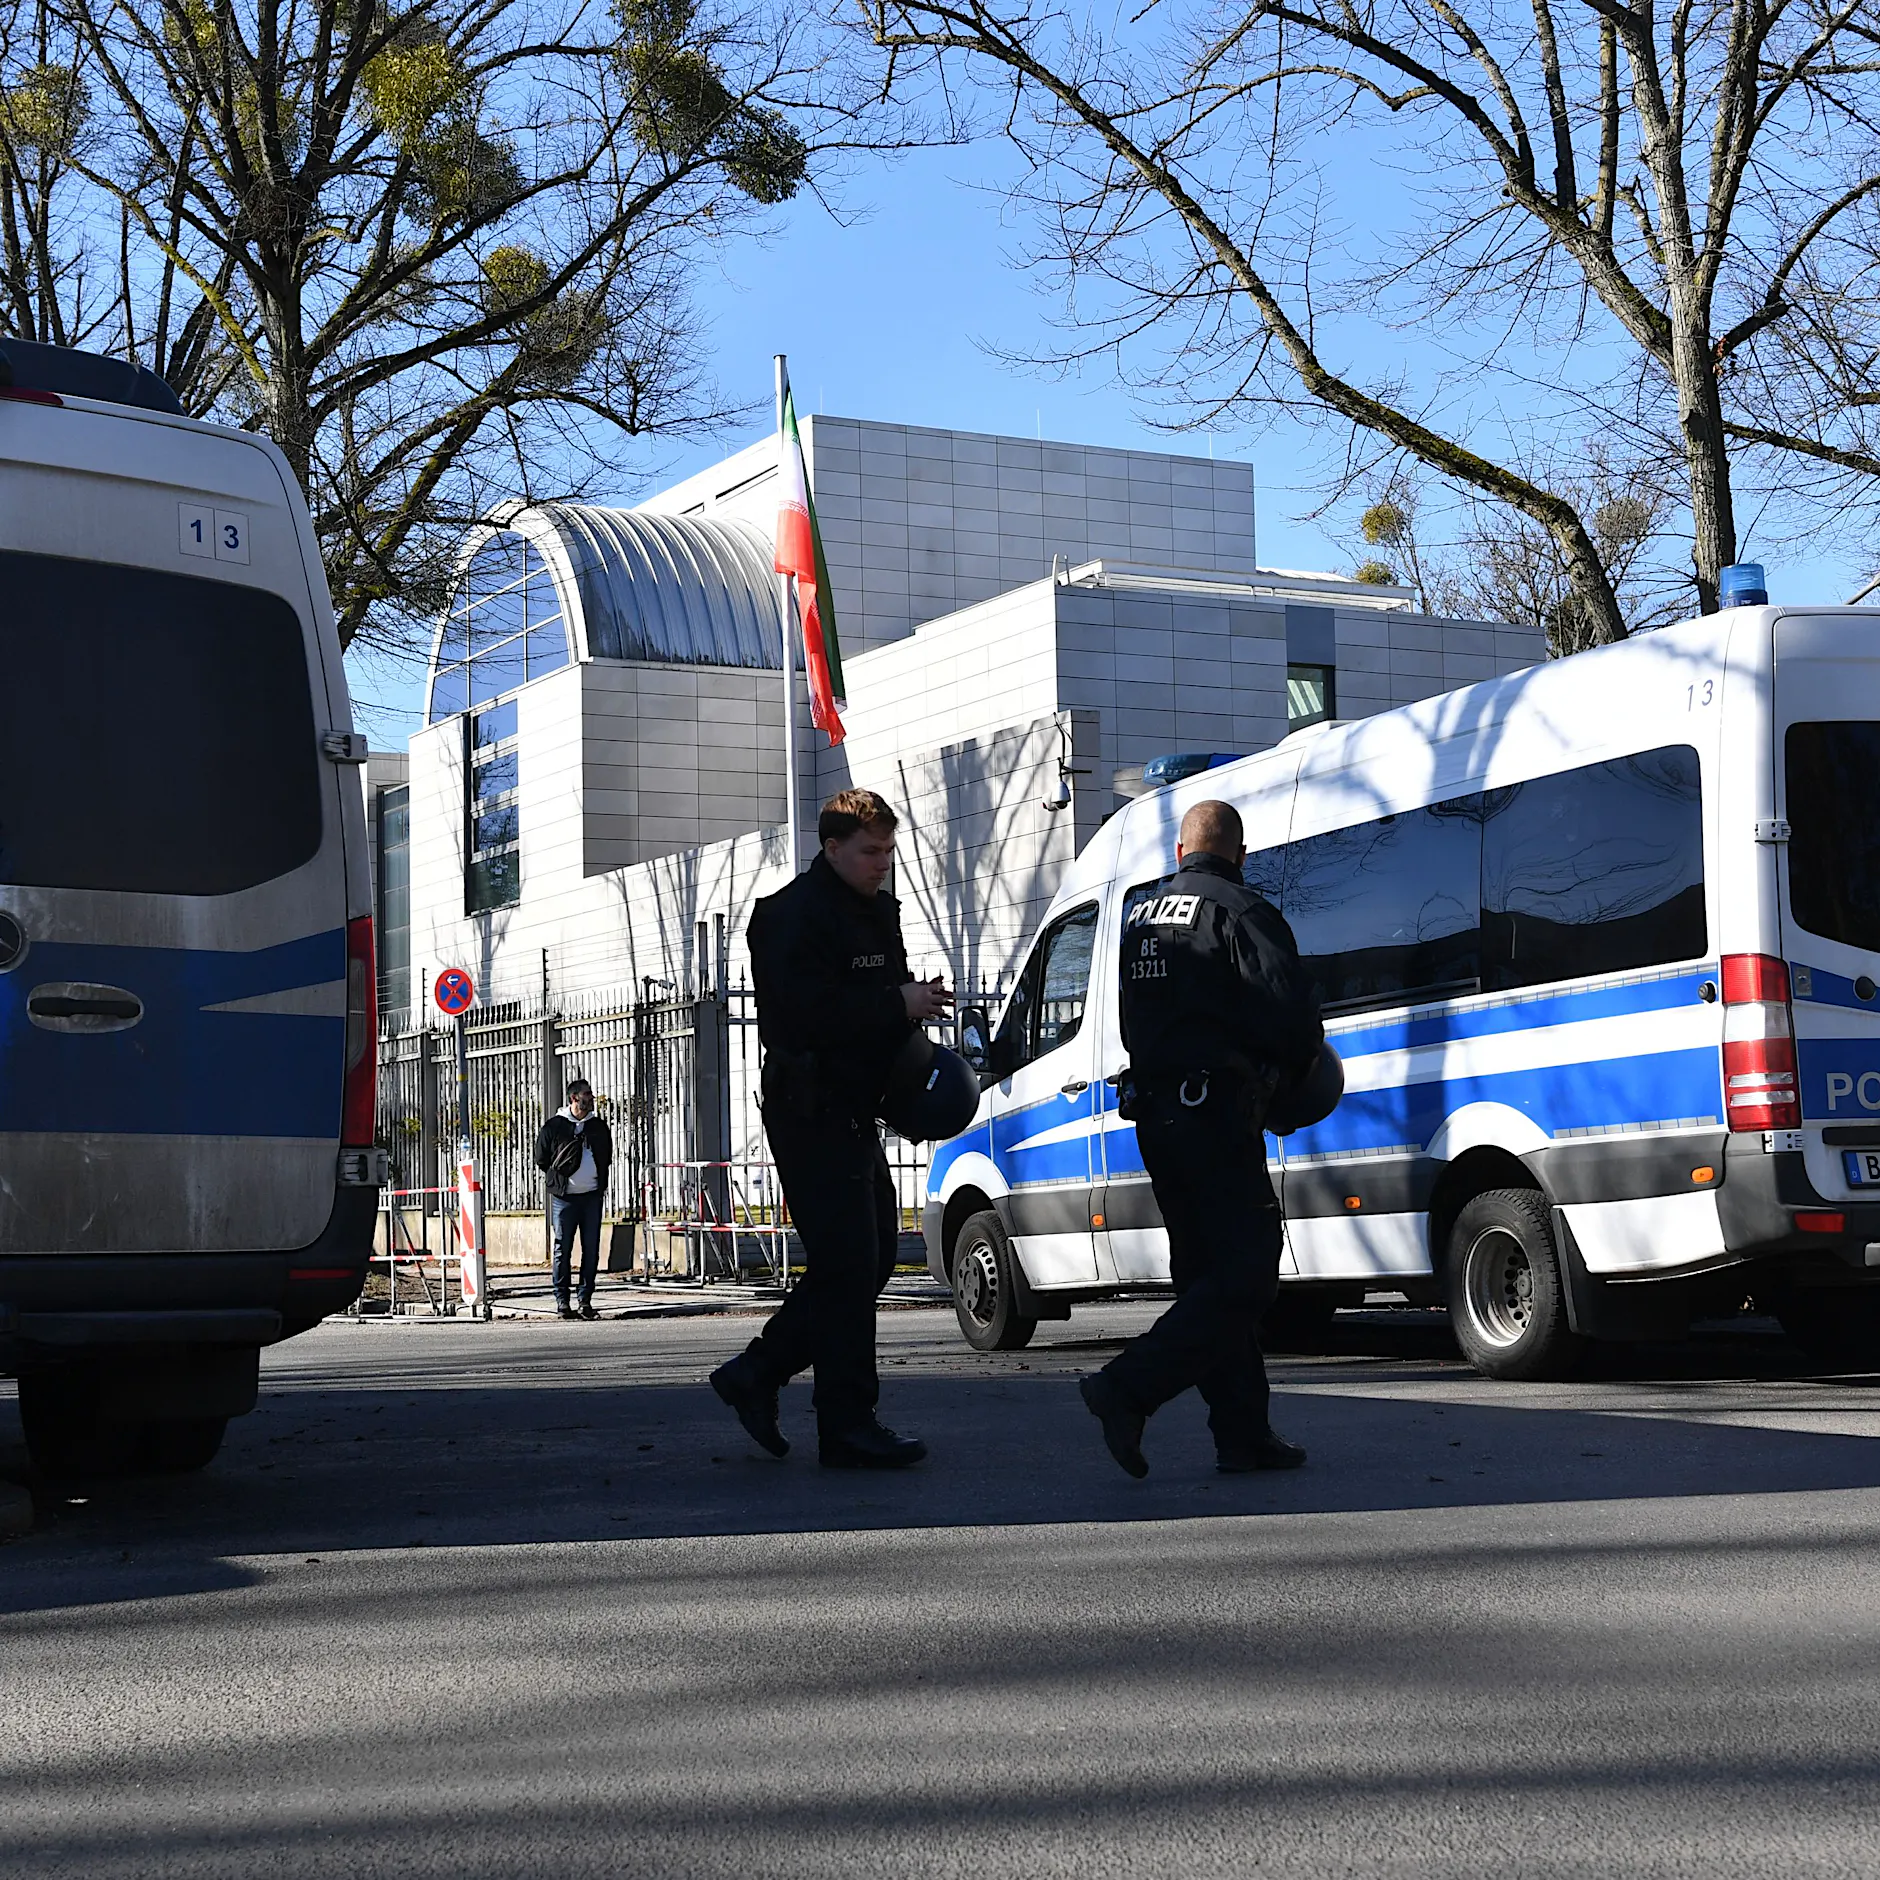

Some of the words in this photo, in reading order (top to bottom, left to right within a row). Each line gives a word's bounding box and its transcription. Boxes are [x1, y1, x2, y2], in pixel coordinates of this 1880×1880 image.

[1687, 679, 1714, 712] 13
[1126, 894, 1201, 933] POLIZEI
[1141, 937, 1158, 957] BE
[851, 954, 885, 969] POLIZEI
[1131, 959, 1167, 980] 13211
[1826, 1071, 1880, 1111] PO
[1865, 1155, 1880, 1180] B
